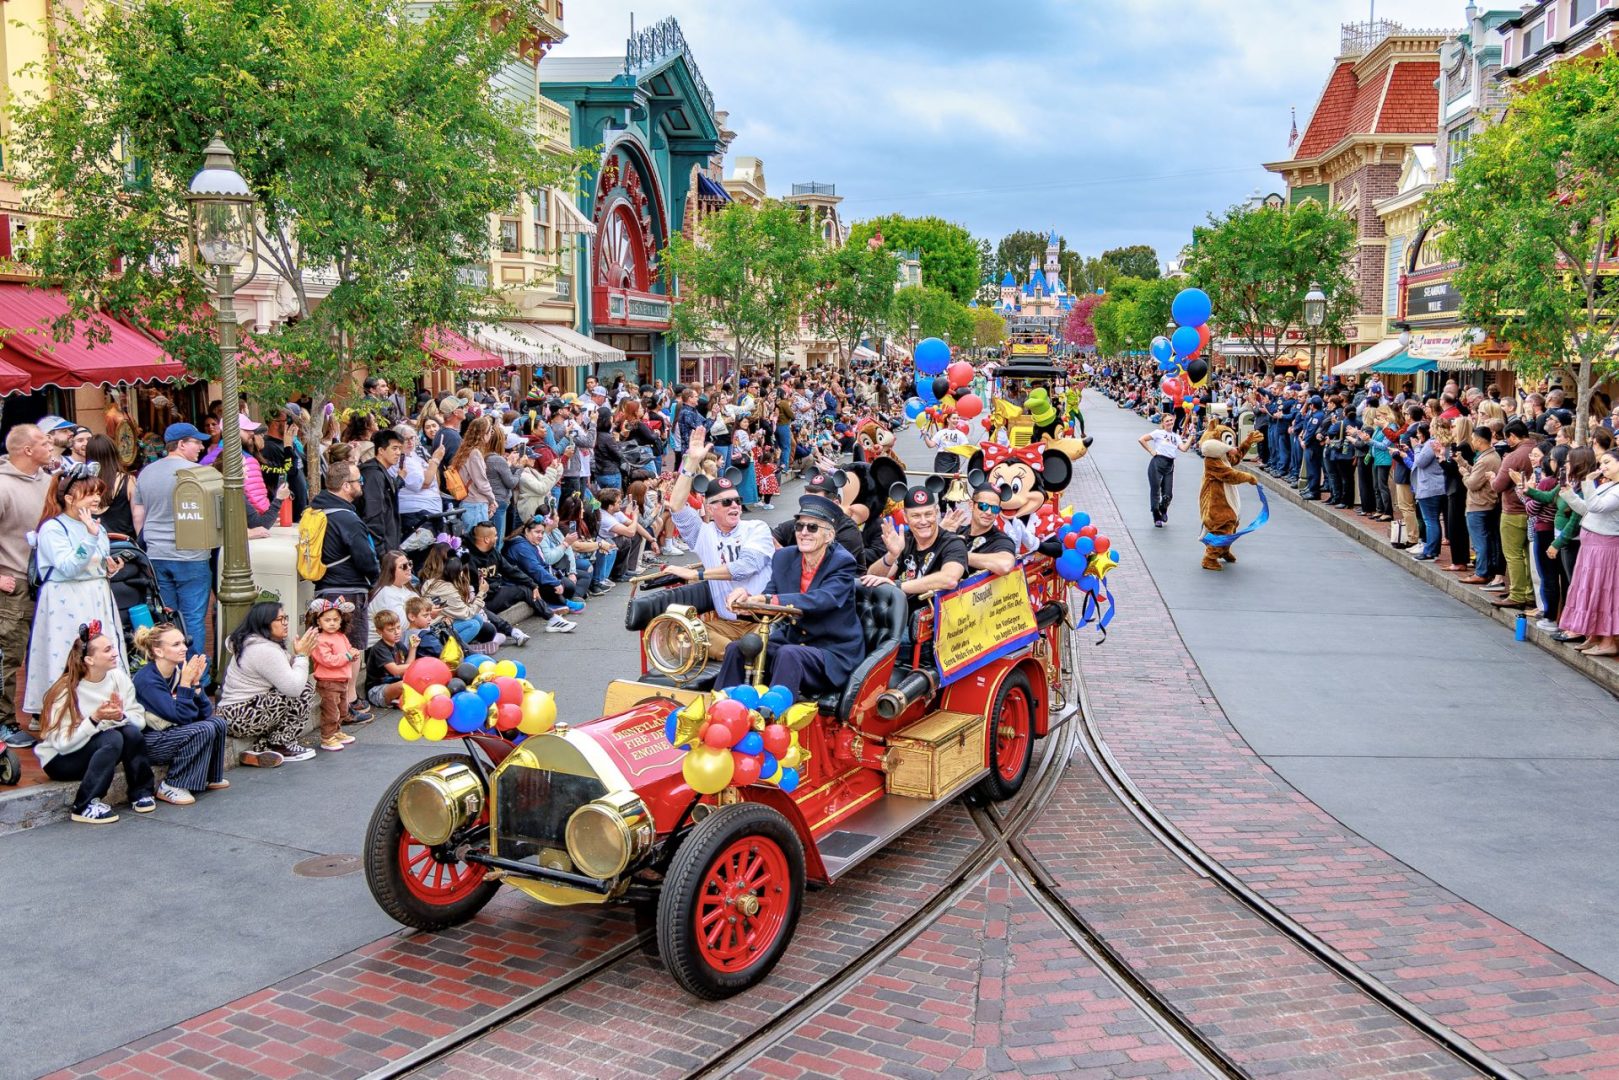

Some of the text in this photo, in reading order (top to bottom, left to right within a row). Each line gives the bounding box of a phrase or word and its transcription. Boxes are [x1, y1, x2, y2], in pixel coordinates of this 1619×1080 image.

[181, 501, 200, 510] U.S.
[177, 512, 204, 520] MAIL
[611, 716, 666, 741] DISNEYLAN
[623, 733, 651, 750] FIRE
[630, 740, 670, 760] ENGINE
